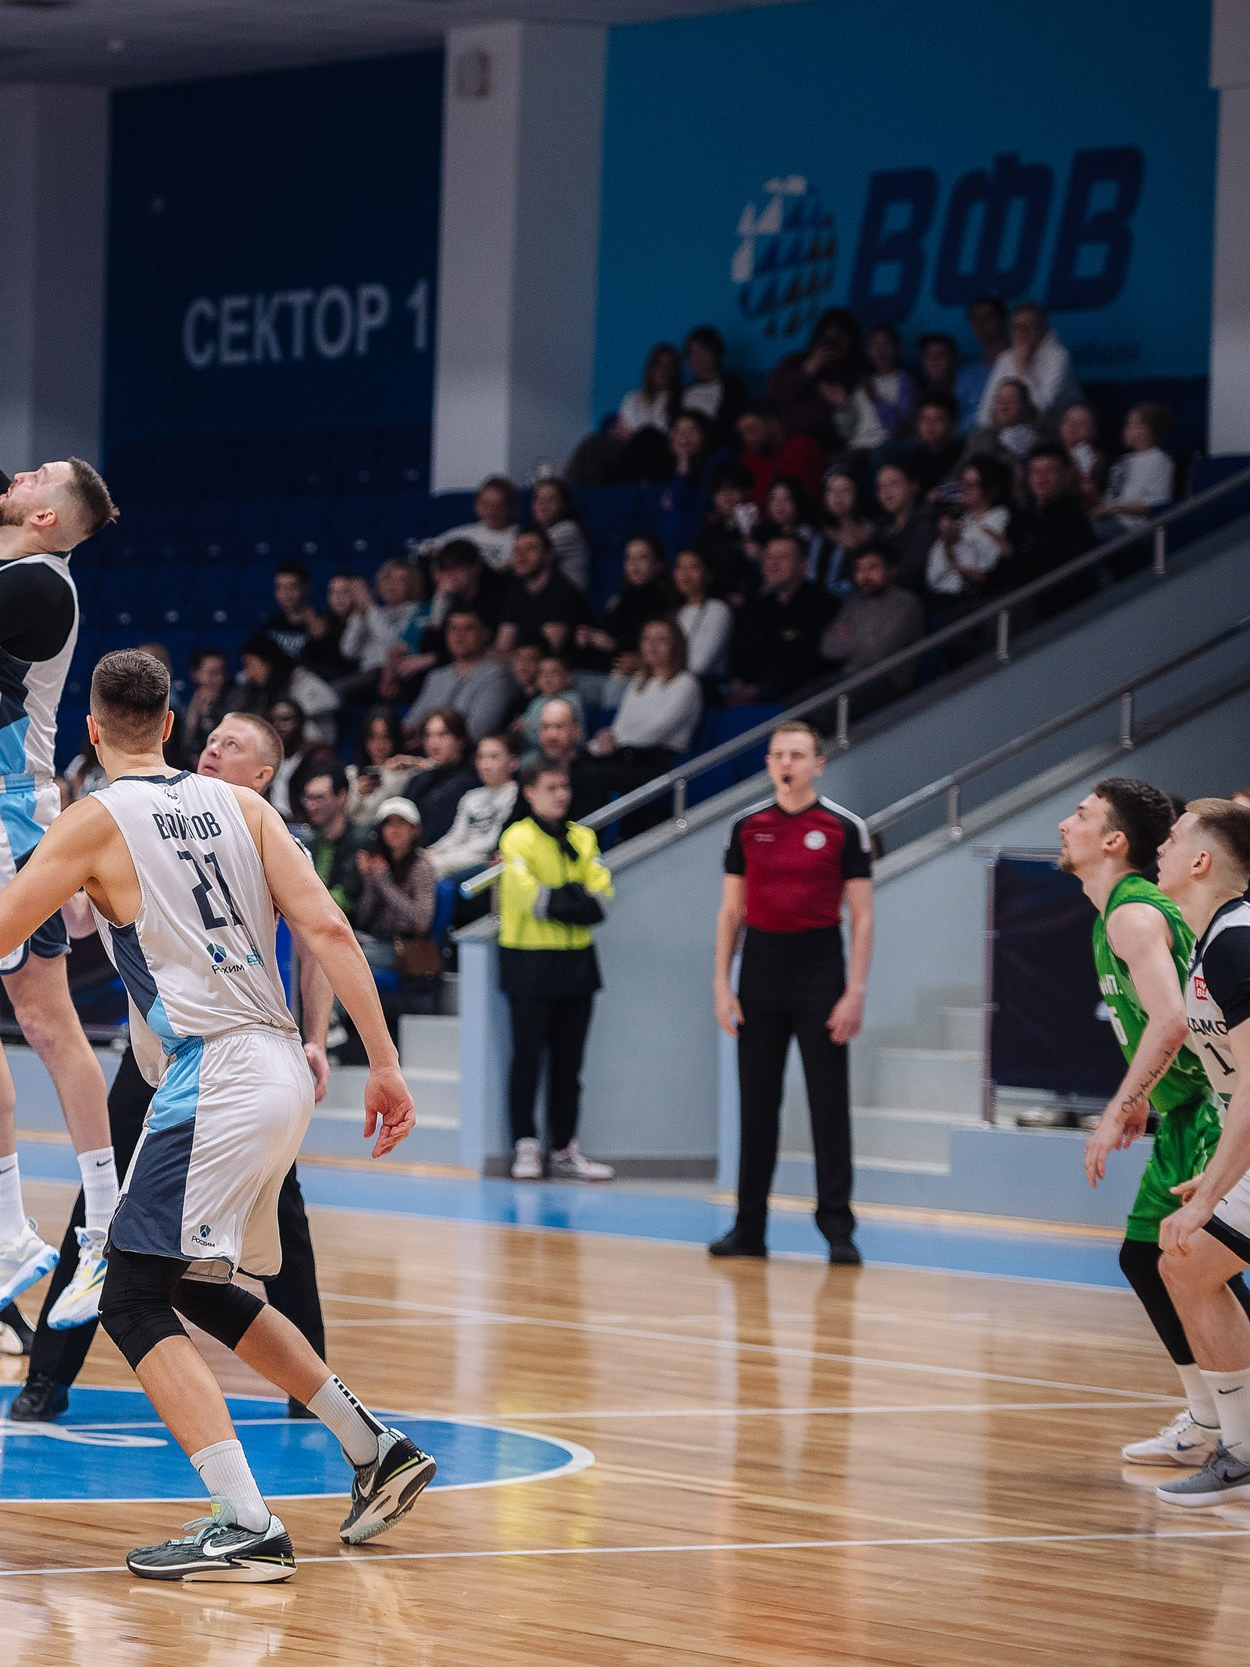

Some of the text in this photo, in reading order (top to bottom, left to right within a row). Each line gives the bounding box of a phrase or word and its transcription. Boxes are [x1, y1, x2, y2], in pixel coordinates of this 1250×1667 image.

[849, 147, 1146, 327] ВФВ
[181, 277, 430, 370] СЕКТОР 1
[177, 850, 244, 931] 21
